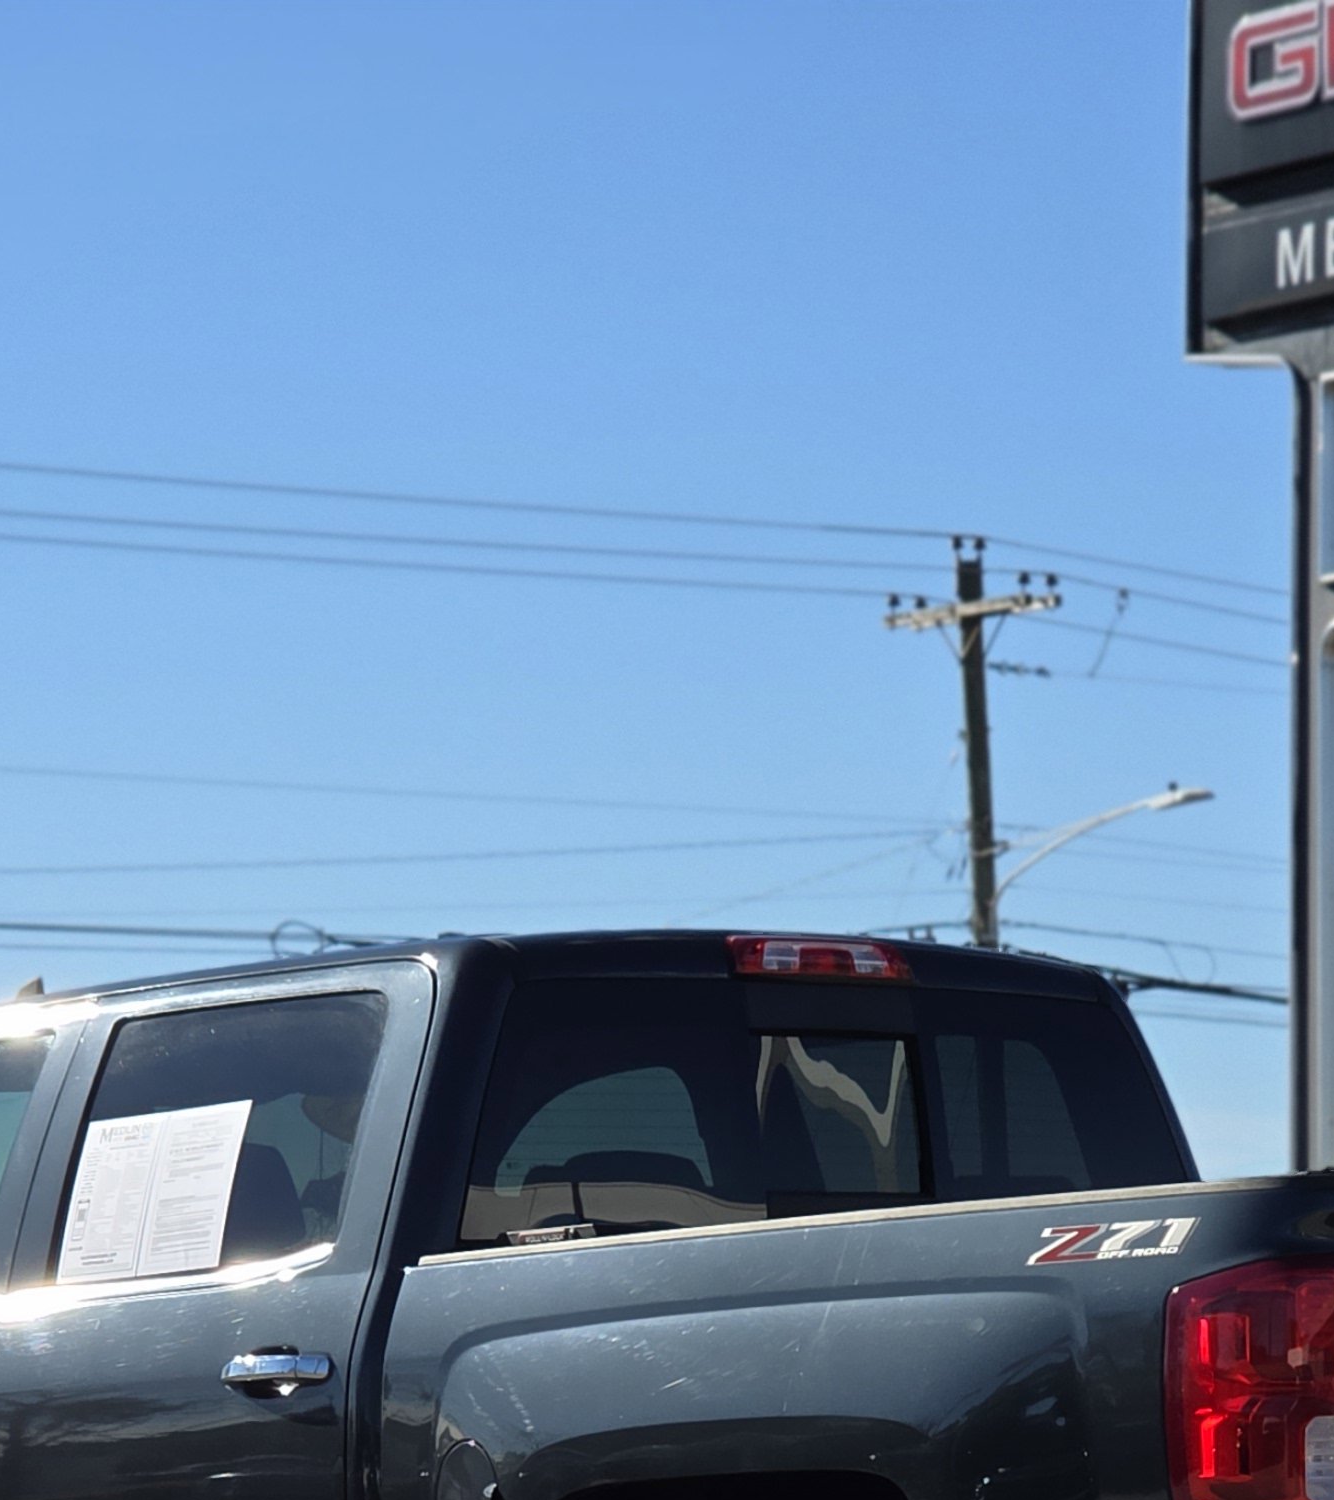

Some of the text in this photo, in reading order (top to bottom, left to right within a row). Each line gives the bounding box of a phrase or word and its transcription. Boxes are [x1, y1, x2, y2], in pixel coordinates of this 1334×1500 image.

[1024, 1216, 1202, 1266] Z71
[1097, 1246, 1179, 1260] OFF ROAD
